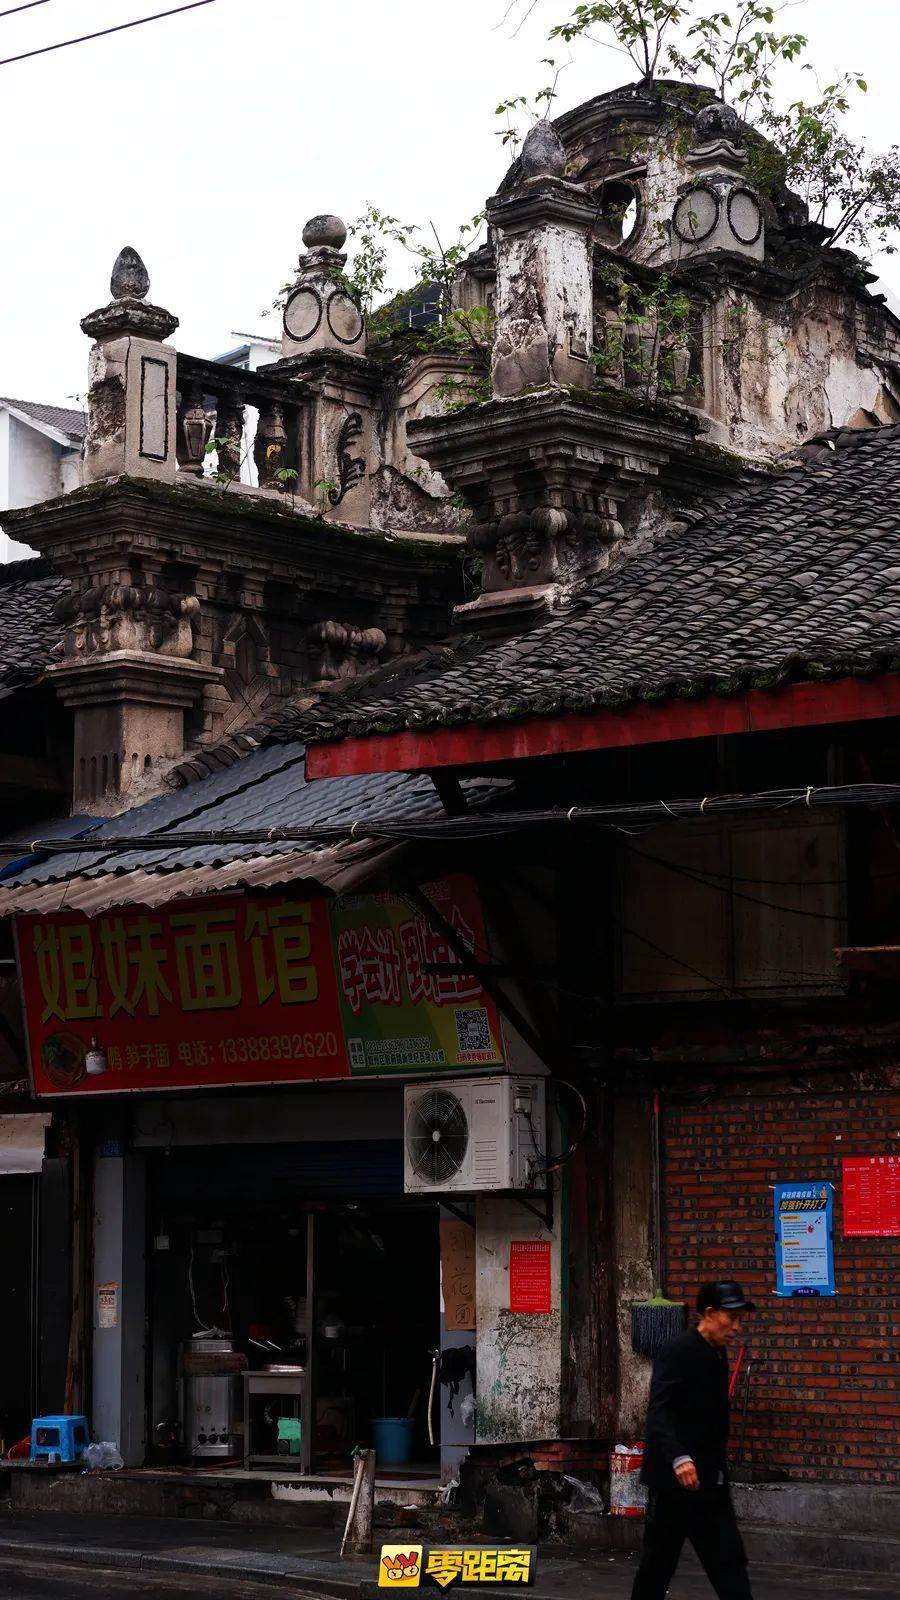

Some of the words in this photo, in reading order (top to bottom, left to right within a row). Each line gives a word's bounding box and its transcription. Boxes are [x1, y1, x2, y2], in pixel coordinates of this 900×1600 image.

[33, 900, 319, 1024] 姐妹面馆
[219, 1031, 338, 1064] 13388392620
